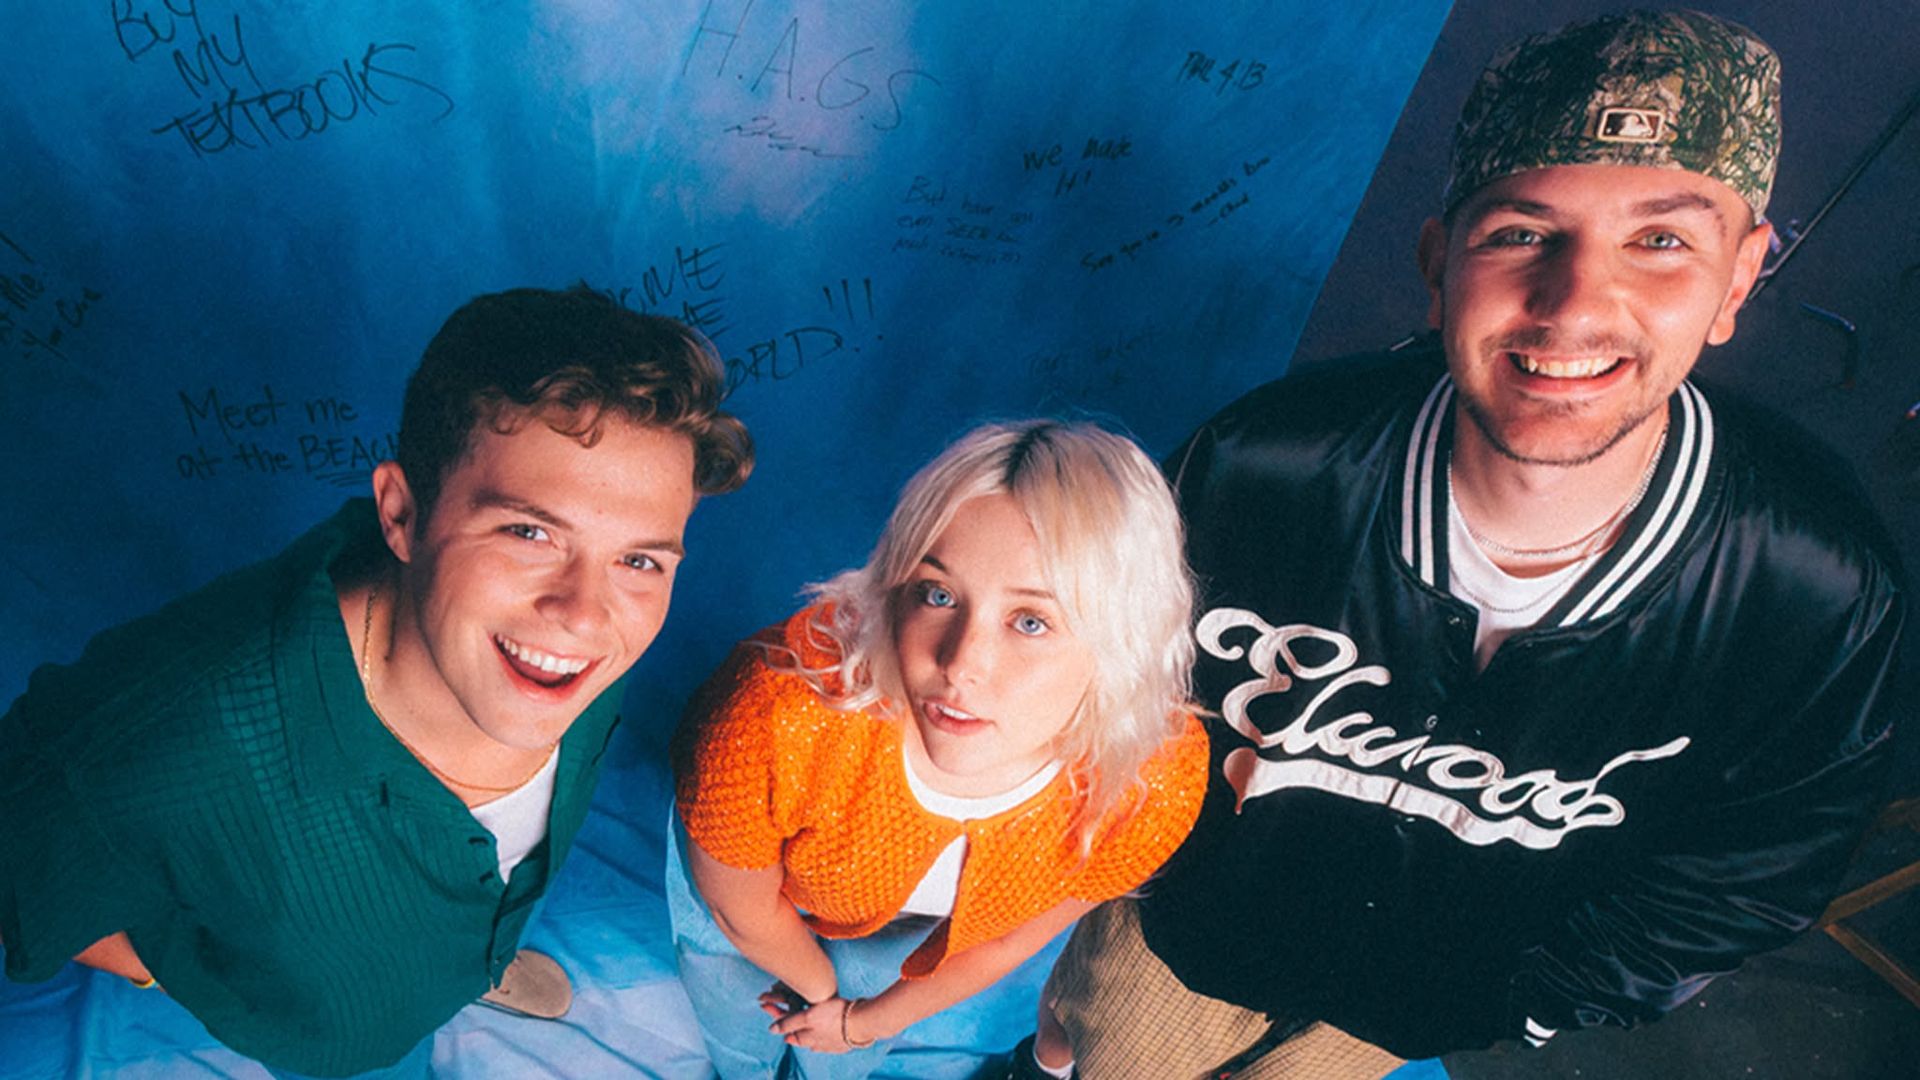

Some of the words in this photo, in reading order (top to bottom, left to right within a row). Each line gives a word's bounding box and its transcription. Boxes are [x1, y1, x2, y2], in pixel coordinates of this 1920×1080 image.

[172, 12, 265, 100] MY
[150, 42, 456, 160] TEXTBOOKS
[178, 384, 288, 446] Meet
[304, 397, 359, 428] me
[175, 444, 224, 481] at
[231, 441, 294, 477] the
